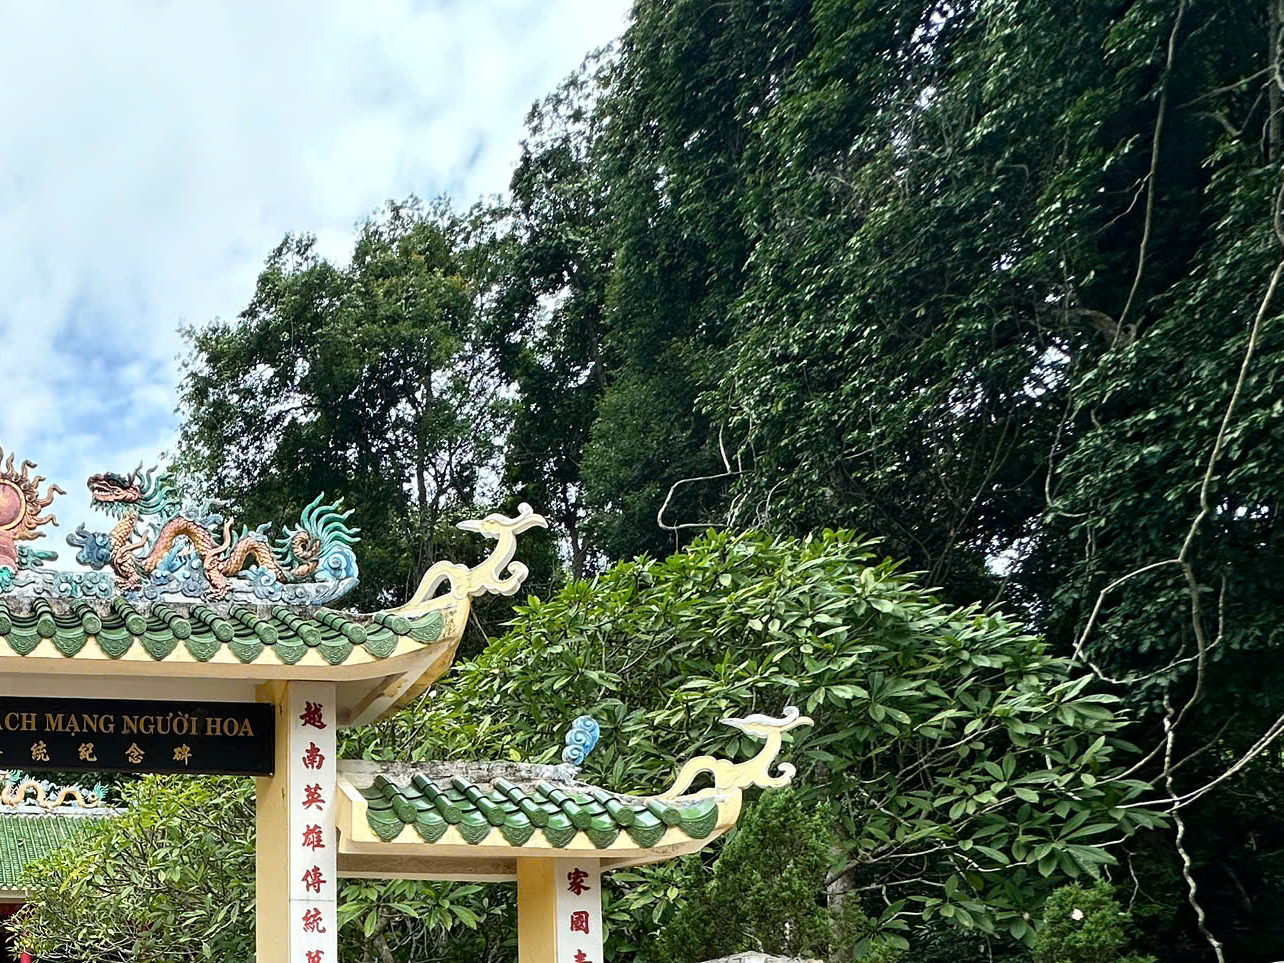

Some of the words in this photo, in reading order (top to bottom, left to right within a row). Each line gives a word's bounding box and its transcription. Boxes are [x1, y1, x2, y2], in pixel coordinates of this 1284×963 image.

[44, 713, 115, 737] MẠNG
[121, 710, 199, 736] NGƯỜI
[205, 717, 255, 737] HOA
